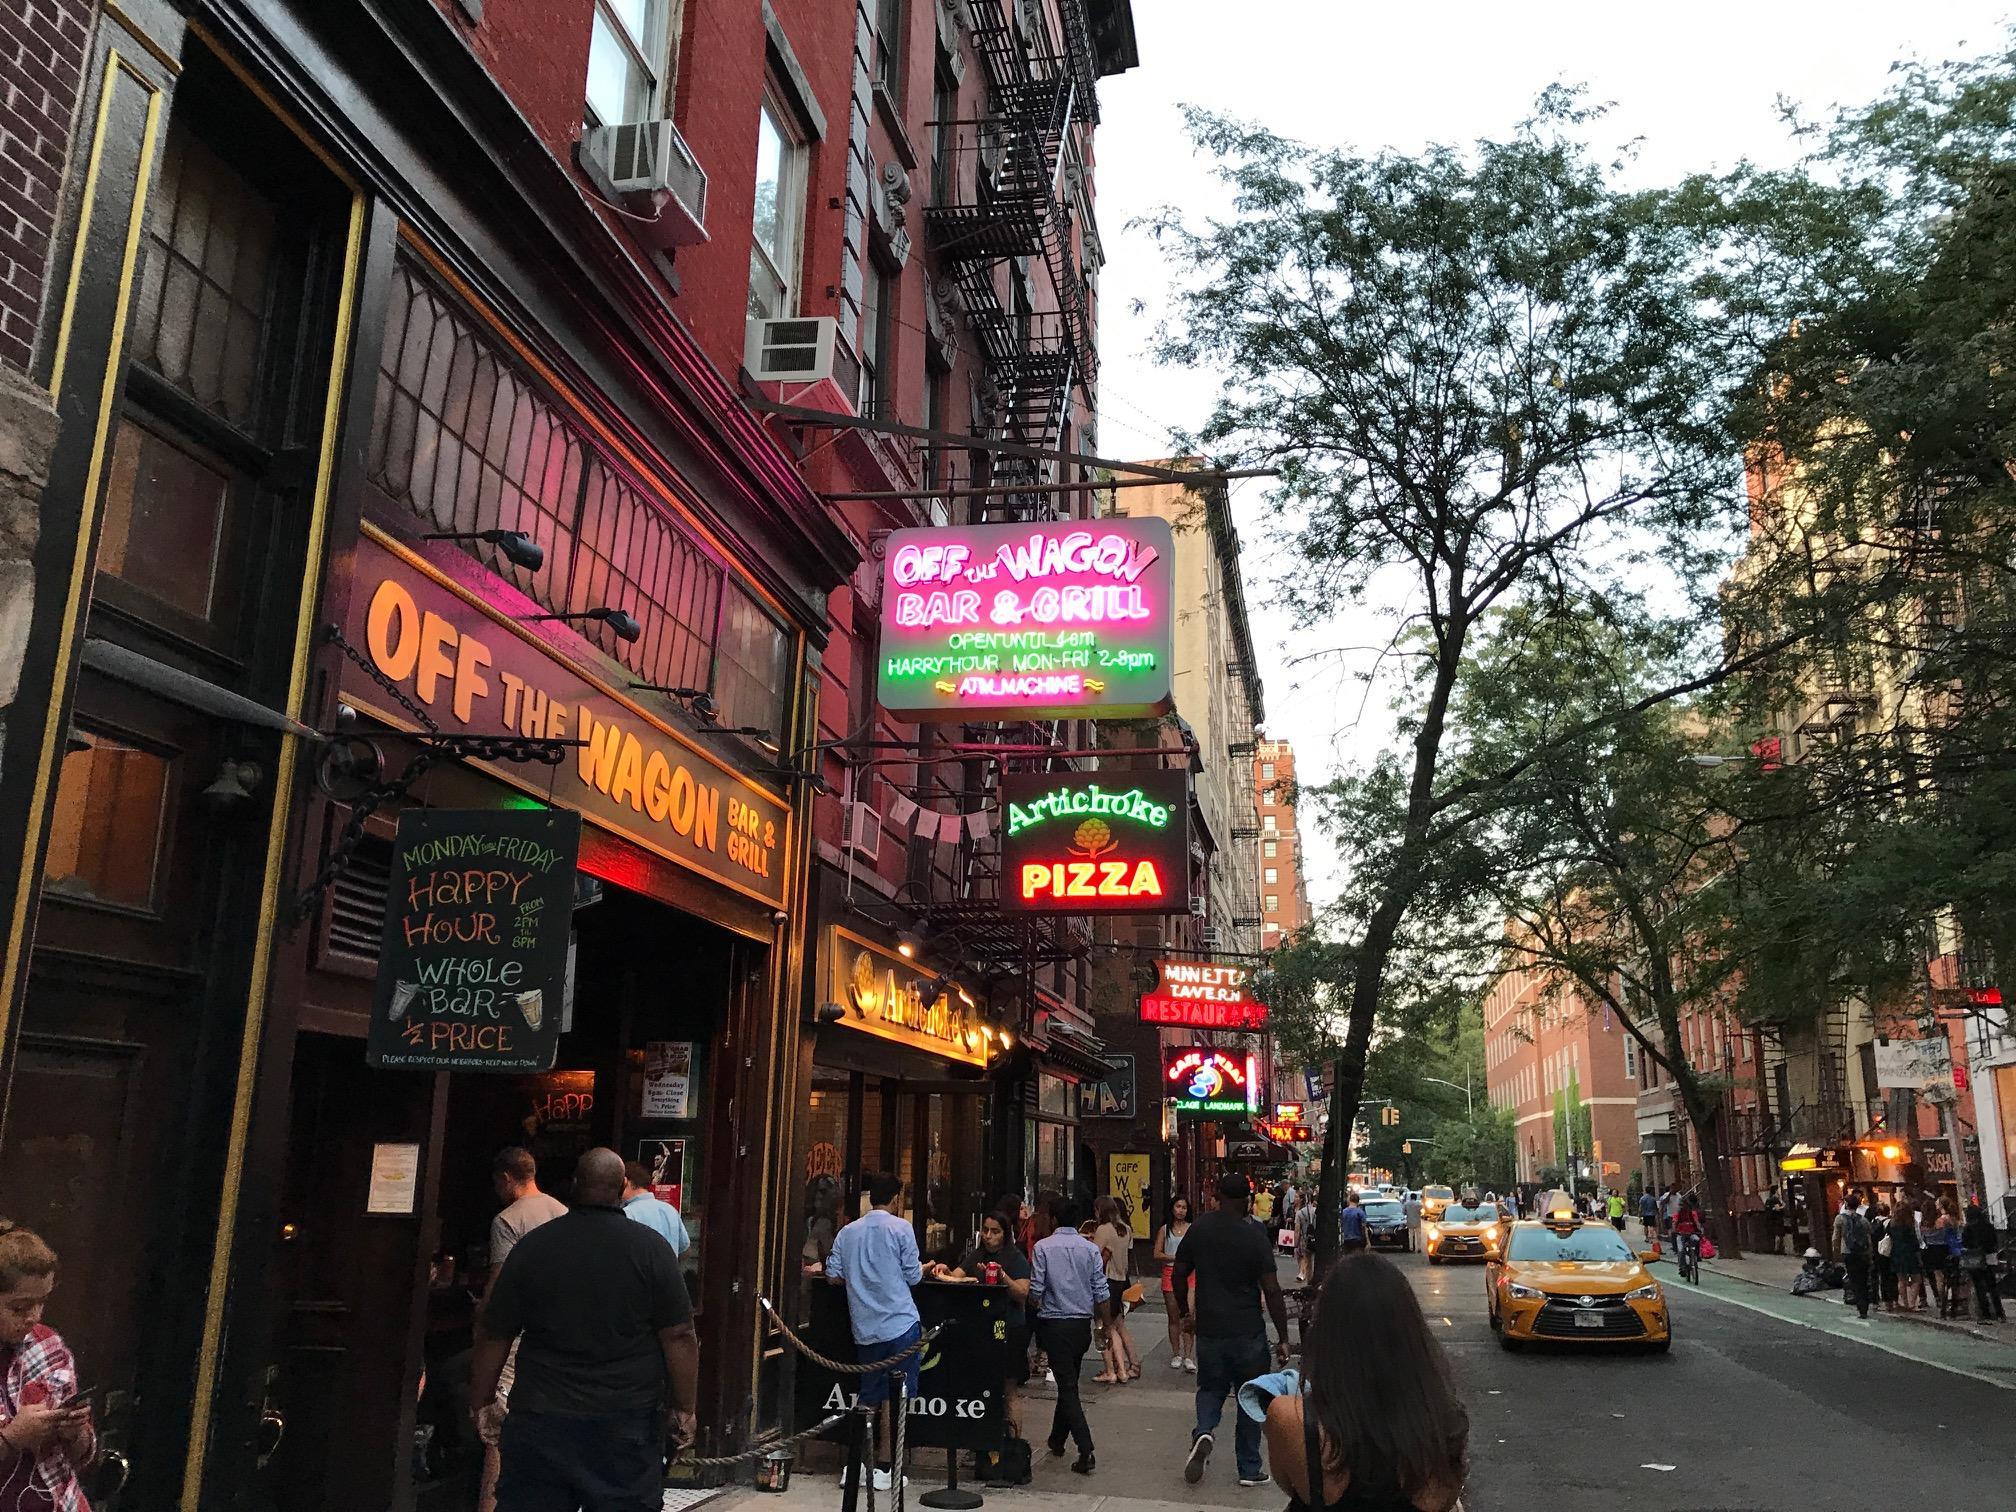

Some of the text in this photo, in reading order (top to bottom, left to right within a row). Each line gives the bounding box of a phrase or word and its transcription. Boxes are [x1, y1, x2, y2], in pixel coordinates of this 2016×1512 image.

[894, 544, 971, 587] OFF
[997, 532, 1159, 584] WAGON
[896, 585, 1150, 626] BAR & GRILL
[949, 632, 997, 650] OPEN
[949, 654, 1000, 673] HOUR
[1013, 649, 1089, 672] MON-FRI
[1000, 674, 1081, 695] MACHINE
[367, 580, 720, 853] OFF THE WAGON
[728, 797, 776, 849] BAR &
[1008, 784, 1168, 836] Artichoke
[403, 834, 484, 872] MONDAY
[496, 836, 563, 874] FRIDAY
[728, 831, 769, 878] GRILL
[1022, 860, 1162, 898] PIZZA
[520, 897, 545, 913] FROM
[514, 916, 539, 928] 2PM
[512, 936, 536, 948] 8PM
[1170, 984, 1241, 1002] TAVERN
[431, 1021, 514, 1051] PRICE
[648, 1081, 685, 1089] Wednesday
[1204, 1102, 1245, 1111] LANDMARK
